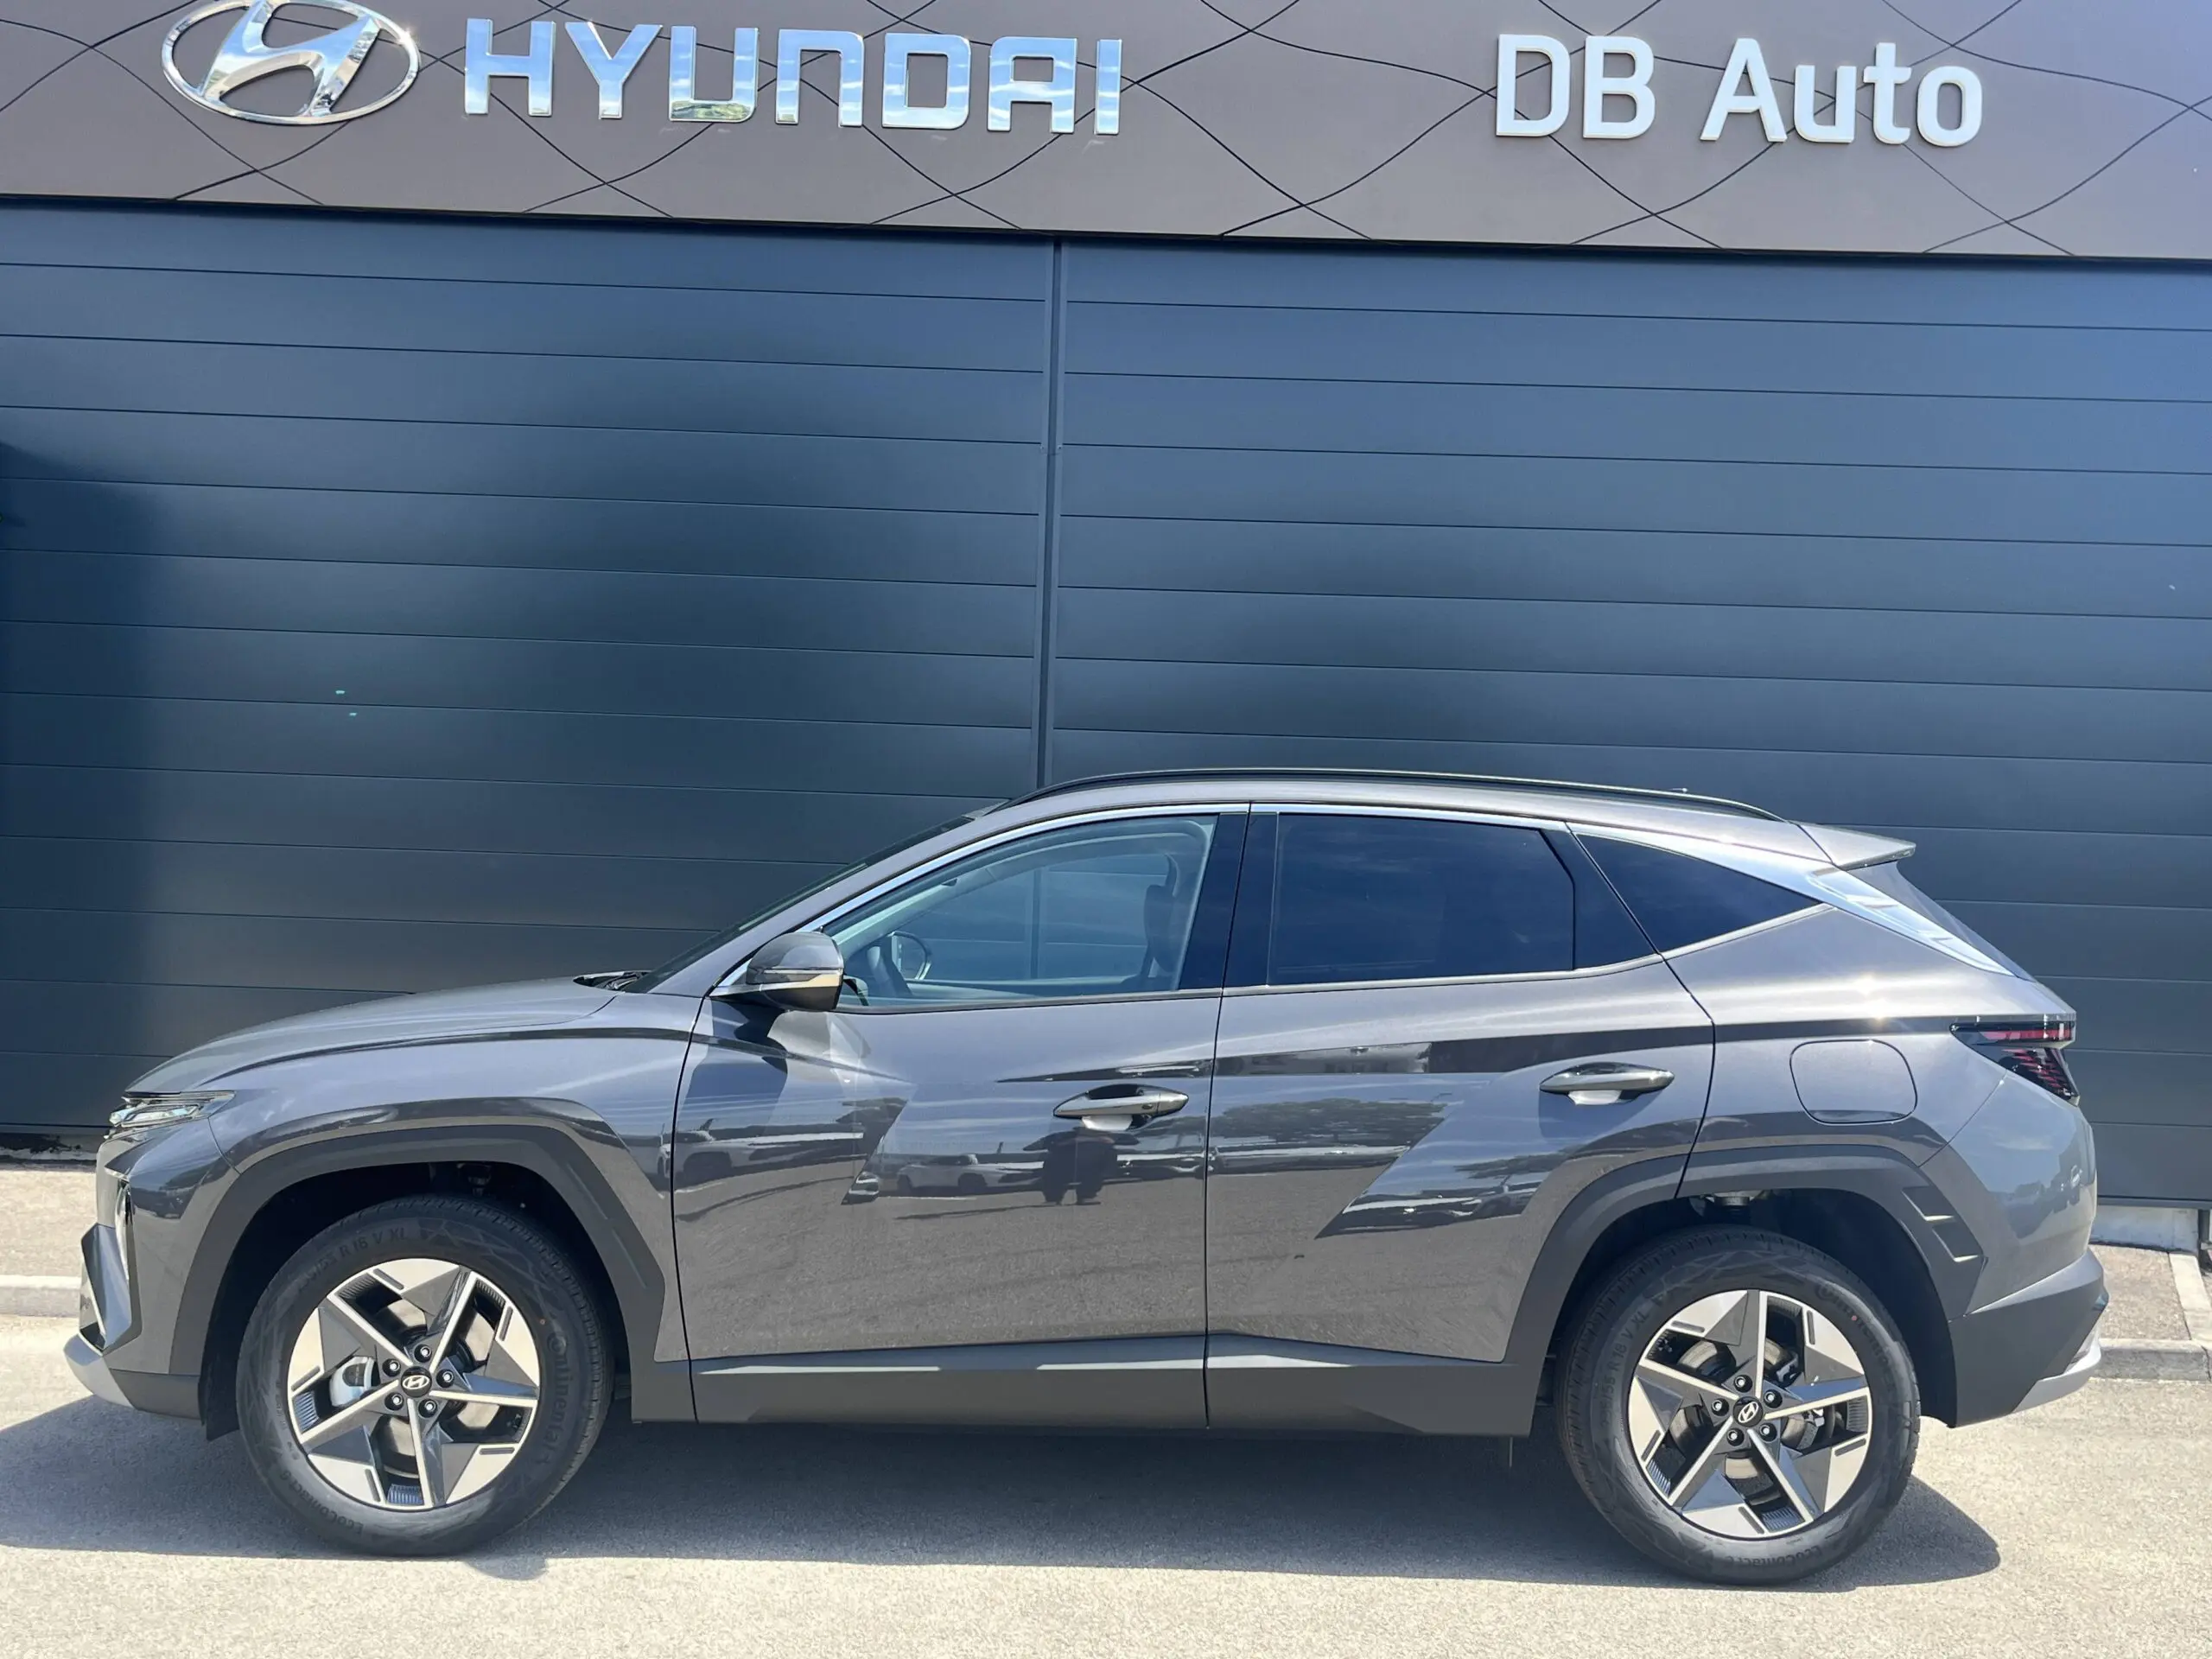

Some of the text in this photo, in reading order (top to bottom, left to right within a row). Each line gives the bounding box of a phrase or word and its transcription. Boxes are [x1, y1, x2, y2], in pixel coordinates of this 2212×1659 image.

[463, 17, 1122, 136] HYUNDAI
[1496, 34, 1983, 147] DB Auto
